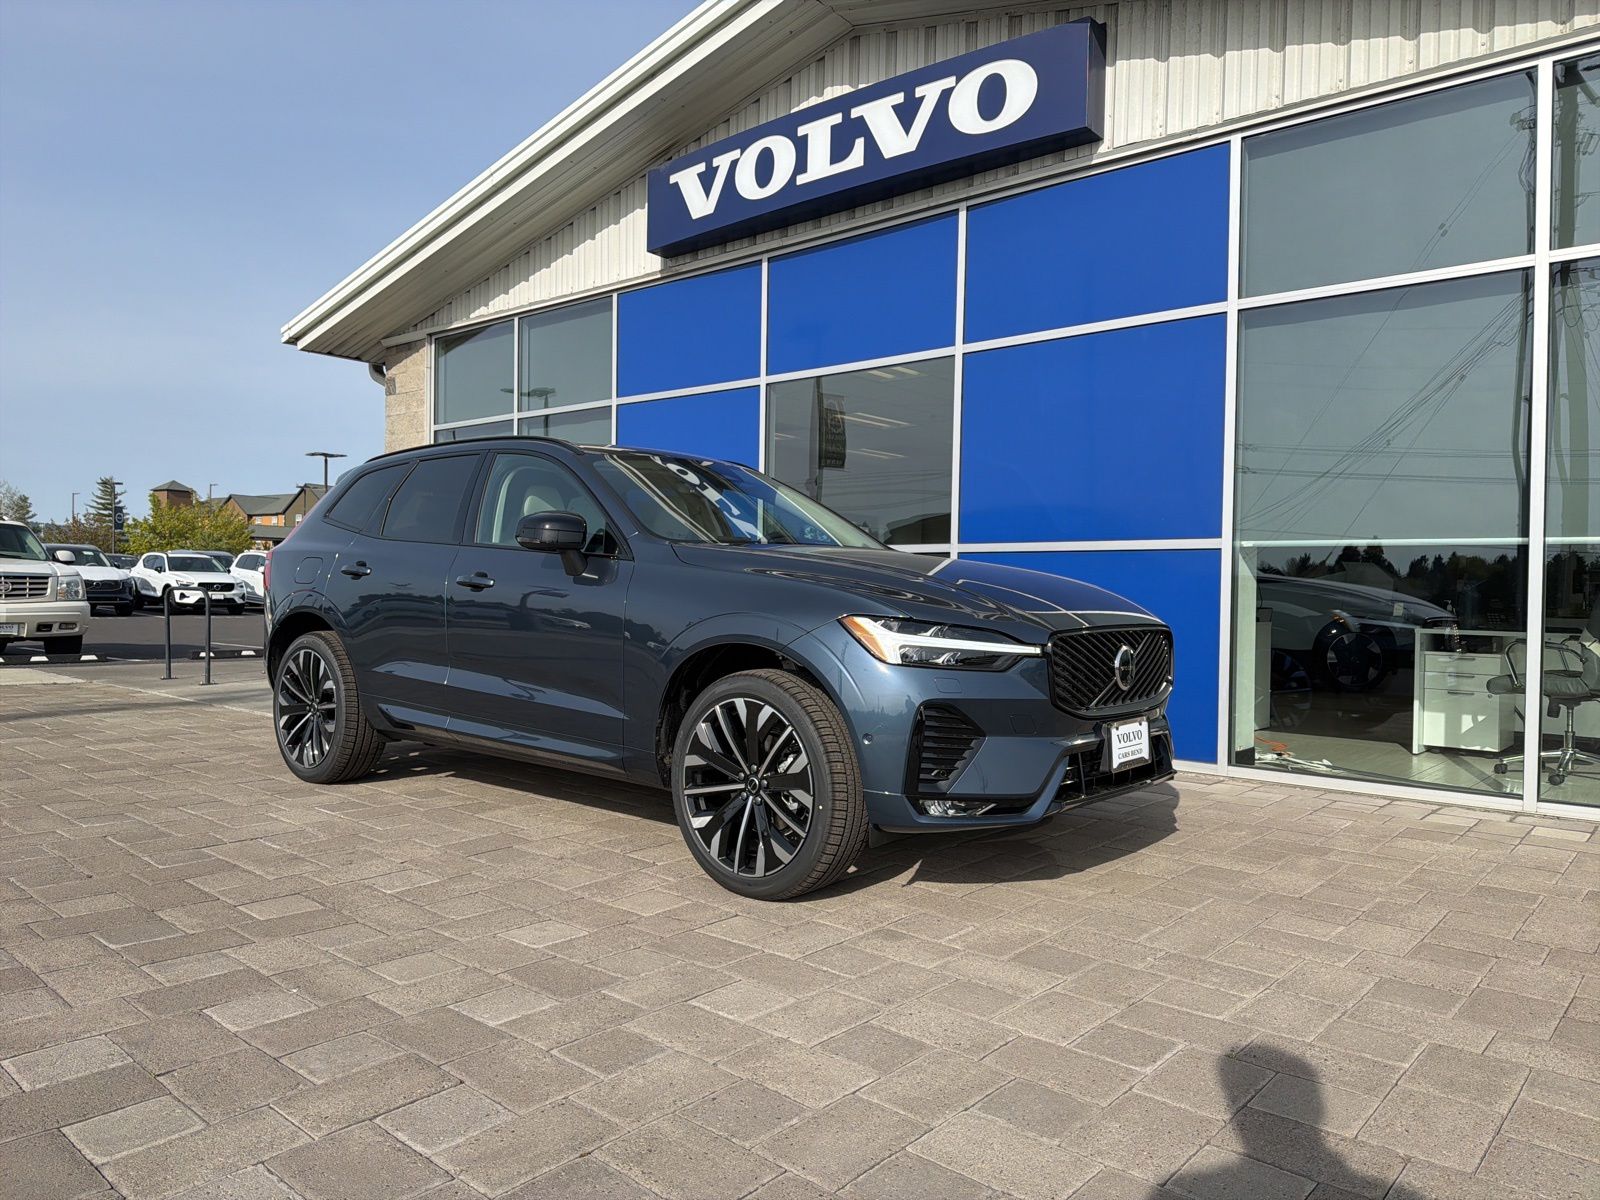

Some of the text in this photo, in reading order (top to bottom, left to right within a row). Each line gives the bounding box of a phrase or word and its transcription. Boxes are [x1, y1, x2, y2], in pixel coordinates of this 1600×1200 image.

[669, 59, 1038, 220] VOLVO
[1116, 729, 1143, 744] VOLVO
[1118, 748, 1143, 760] CARS BEND
